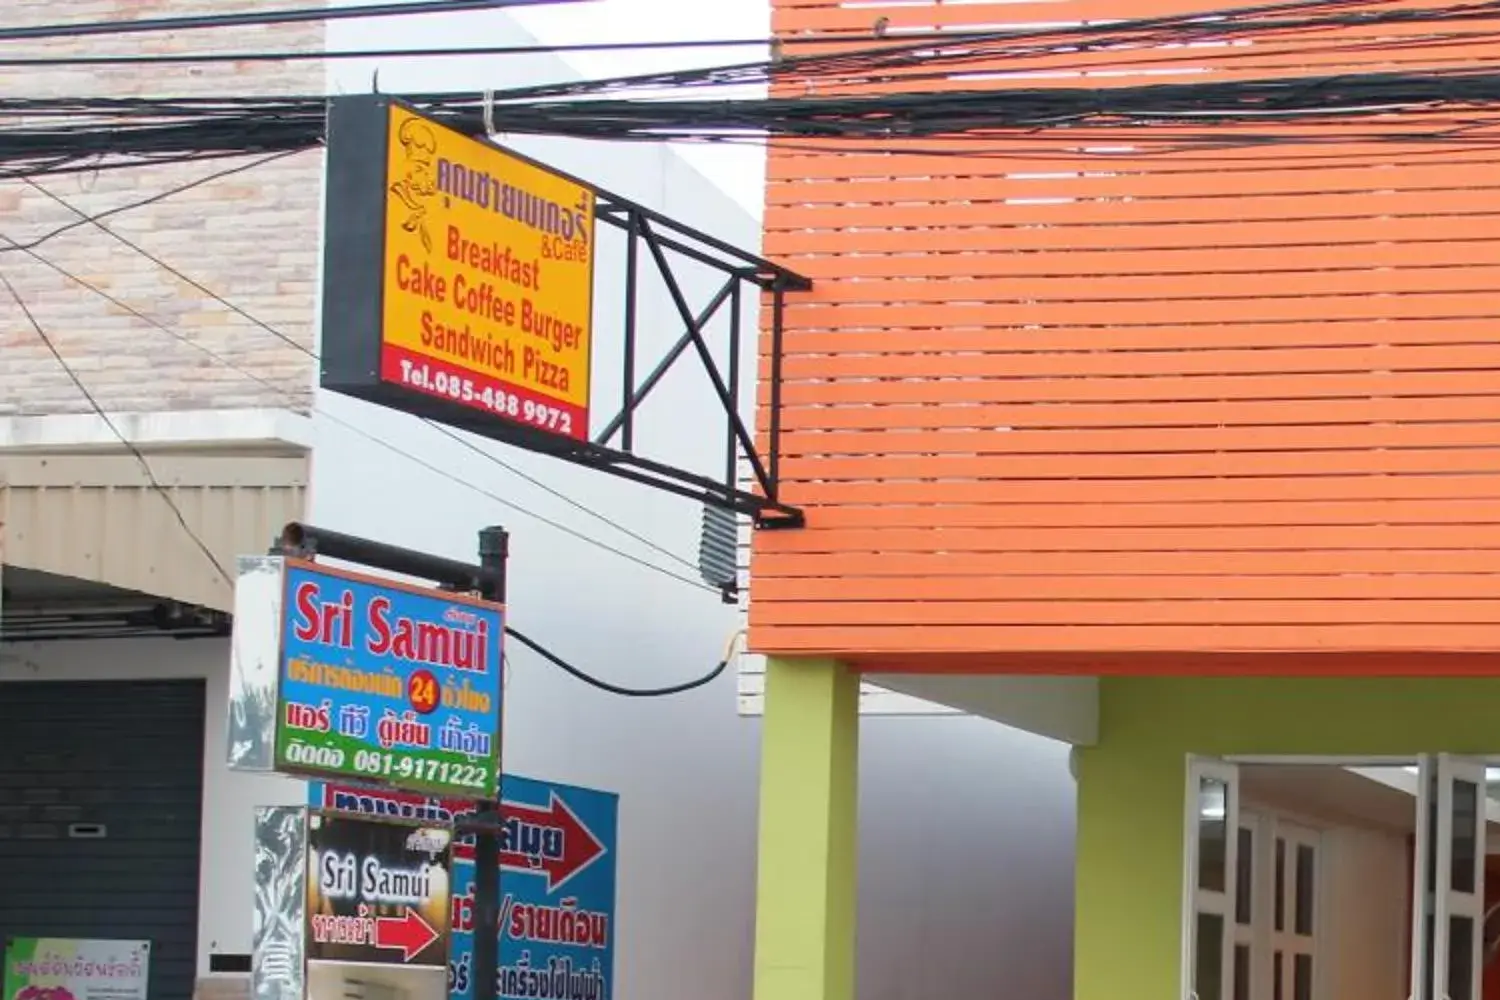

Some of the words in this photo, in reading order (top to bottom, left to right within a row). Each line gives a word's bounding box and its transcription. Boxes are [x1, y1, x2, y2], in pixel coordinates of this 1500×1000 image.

[447, 225, 540, 292] Breakfast
[396, 253, 447, 302] Cake
[453, 273, 515, 327] Coffee
[521, 298, 583, 353] Burger
[420, 310, 515, 375] Sandwich
[523, 345, 570, 392] Pizza
[400, 359, 519, 417] Tel.085-488
[523, 399, 572, 433] 9972
[294, 583, 353, 648] Sri
[367, 597, 488, 673] Samui
[410, 676, 434, 705] 24
[285, 737, 345, 768] ติดต่อ
[354, 750, 488, 788] 081-9171222
[286, 698, 331, 733] แอร์
[339, 703, 370, 738] ทีวี
[378, 707, 431, 749] ตู้เย็น
[439, 714, 491, 763] น้ำอุ่น
[323, 854, 355, 893] Sri
[363, 860, 431, 898] Samui
